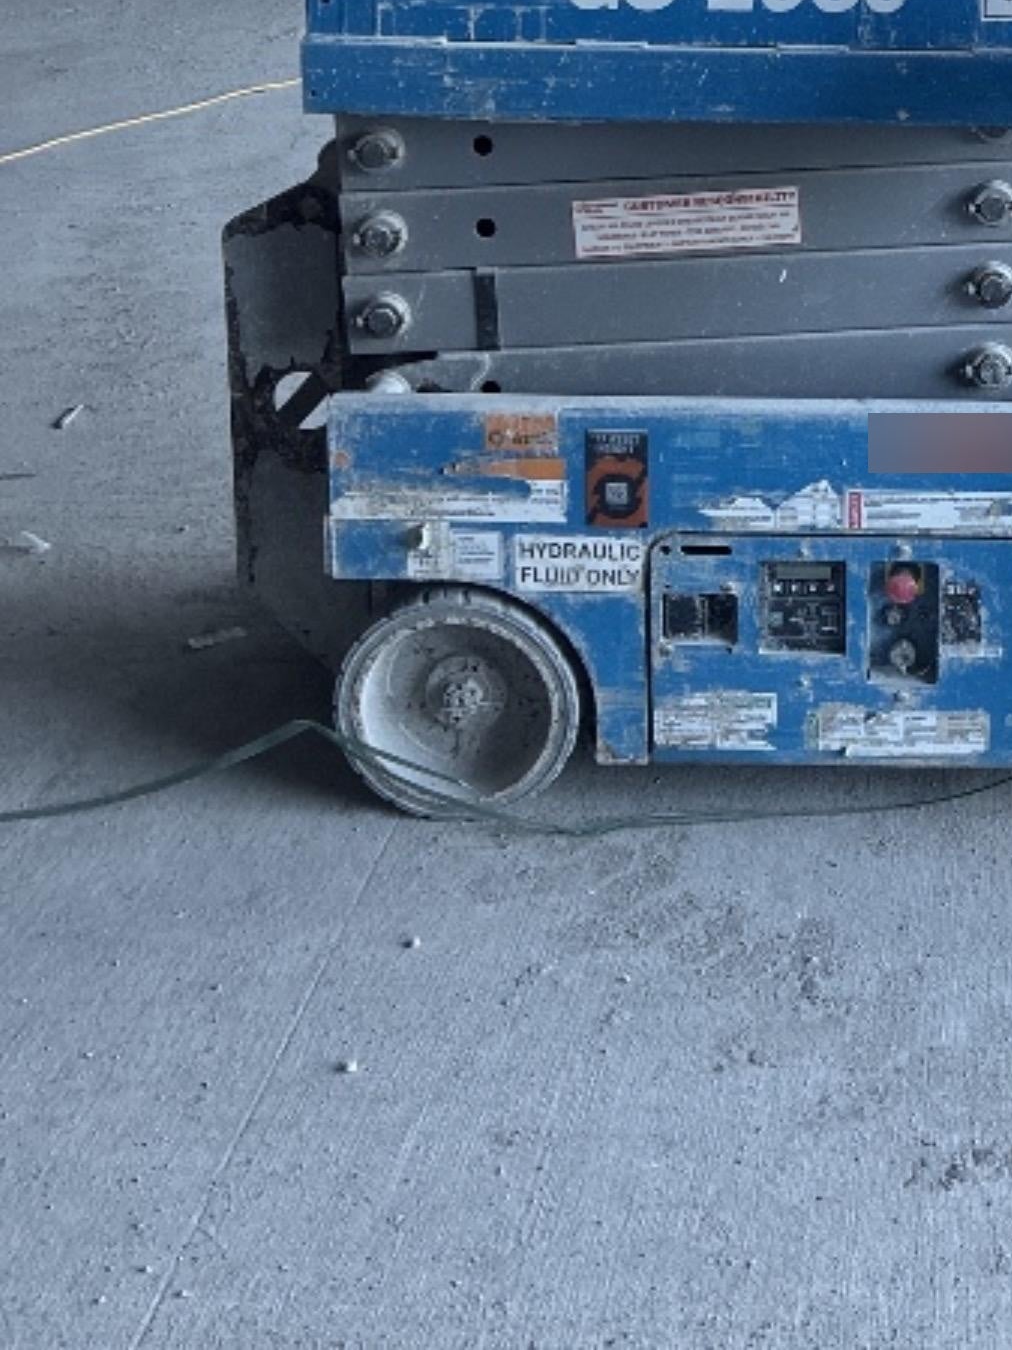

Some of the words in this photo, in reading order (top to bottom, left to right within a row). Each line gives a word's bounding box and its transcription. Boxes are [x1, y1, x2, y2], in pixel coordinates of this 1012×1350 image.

[520, 541, 641, 562] HYDRAULIC
[520, 566, 580, 586] FLUID
[586, 568, 640, 587] ONLY
